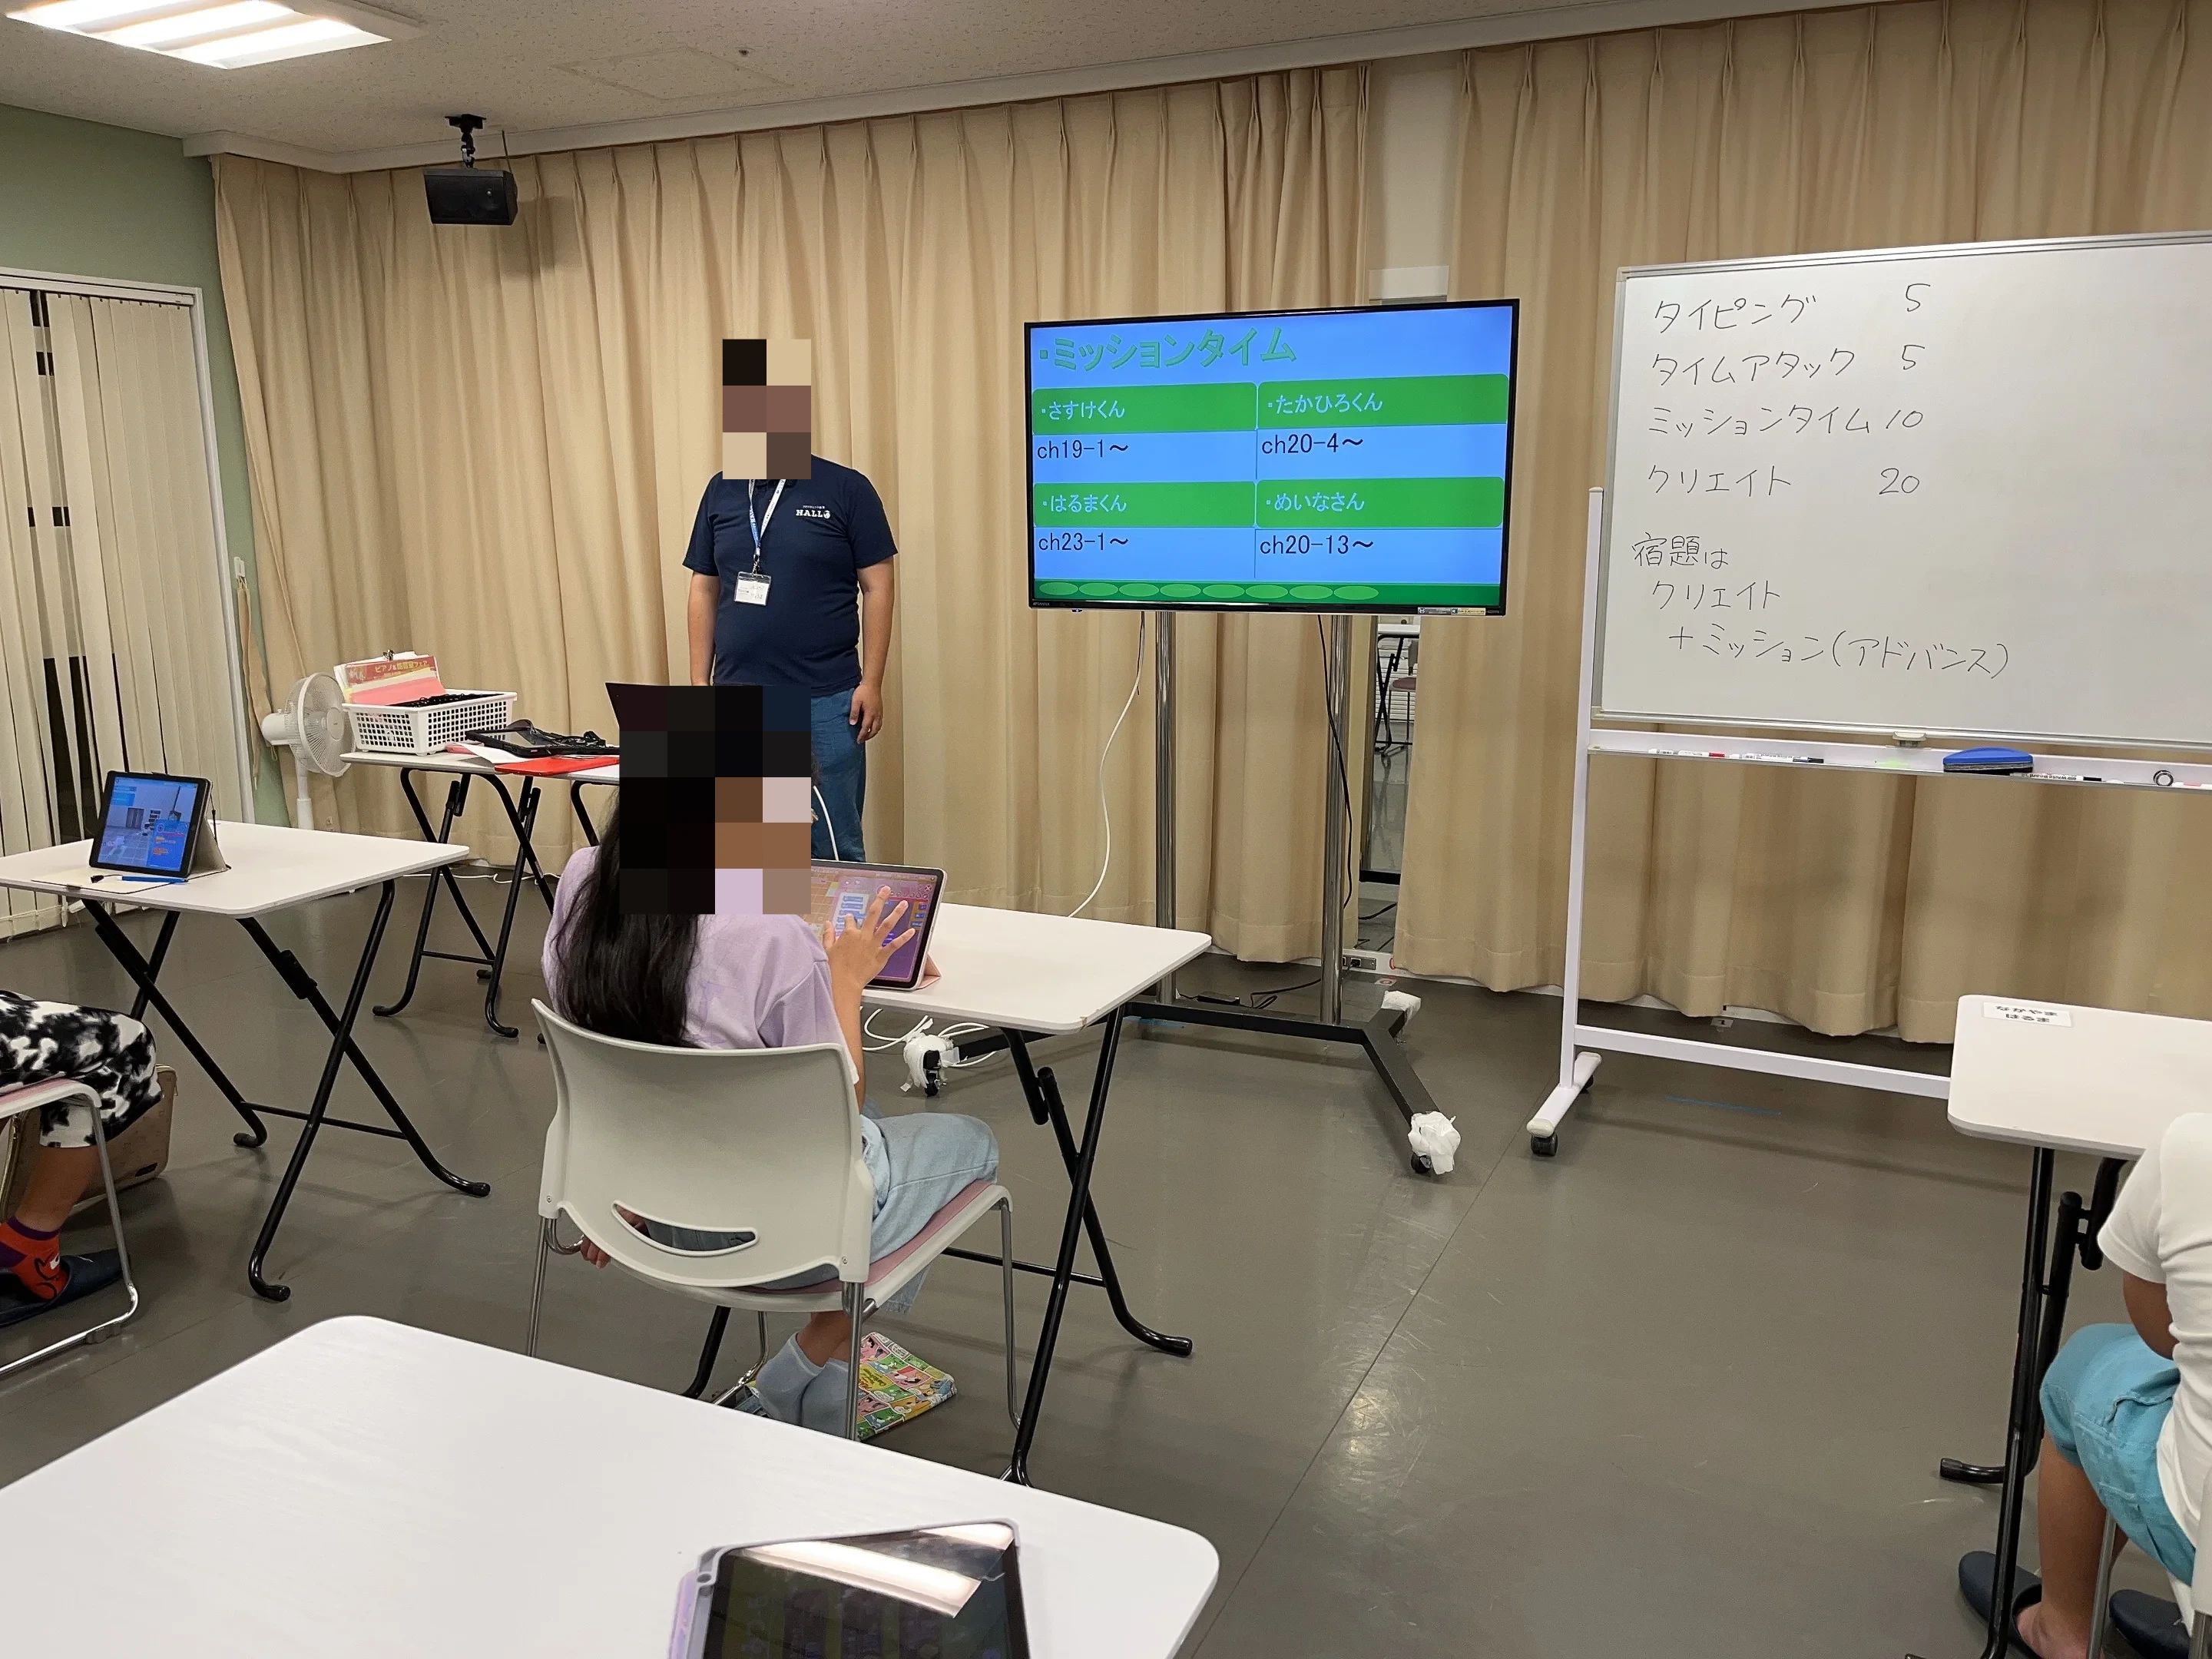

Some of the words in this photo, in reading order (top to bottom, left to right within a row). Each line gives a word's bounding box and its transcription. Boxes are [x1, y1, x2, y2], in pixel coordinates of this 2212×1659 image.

[1654, 293, 1816, 334] タイピング
[1905, 283, 1931, 313] 5
[1652, 348, 1855, 386] タイムアタック
[1901, 344, 1926, 371] 5
[1648, 405, 1870, 438] ミッションタイム
[1885, 409, 1924, 430] 10
[1647, 464, 1791, 498] クリエイト
[1878, 467, 1920, 495] 20
[1631, 531, 1729, 570] 宿題は
[1652, 580, 1780, 611] クリエイト
